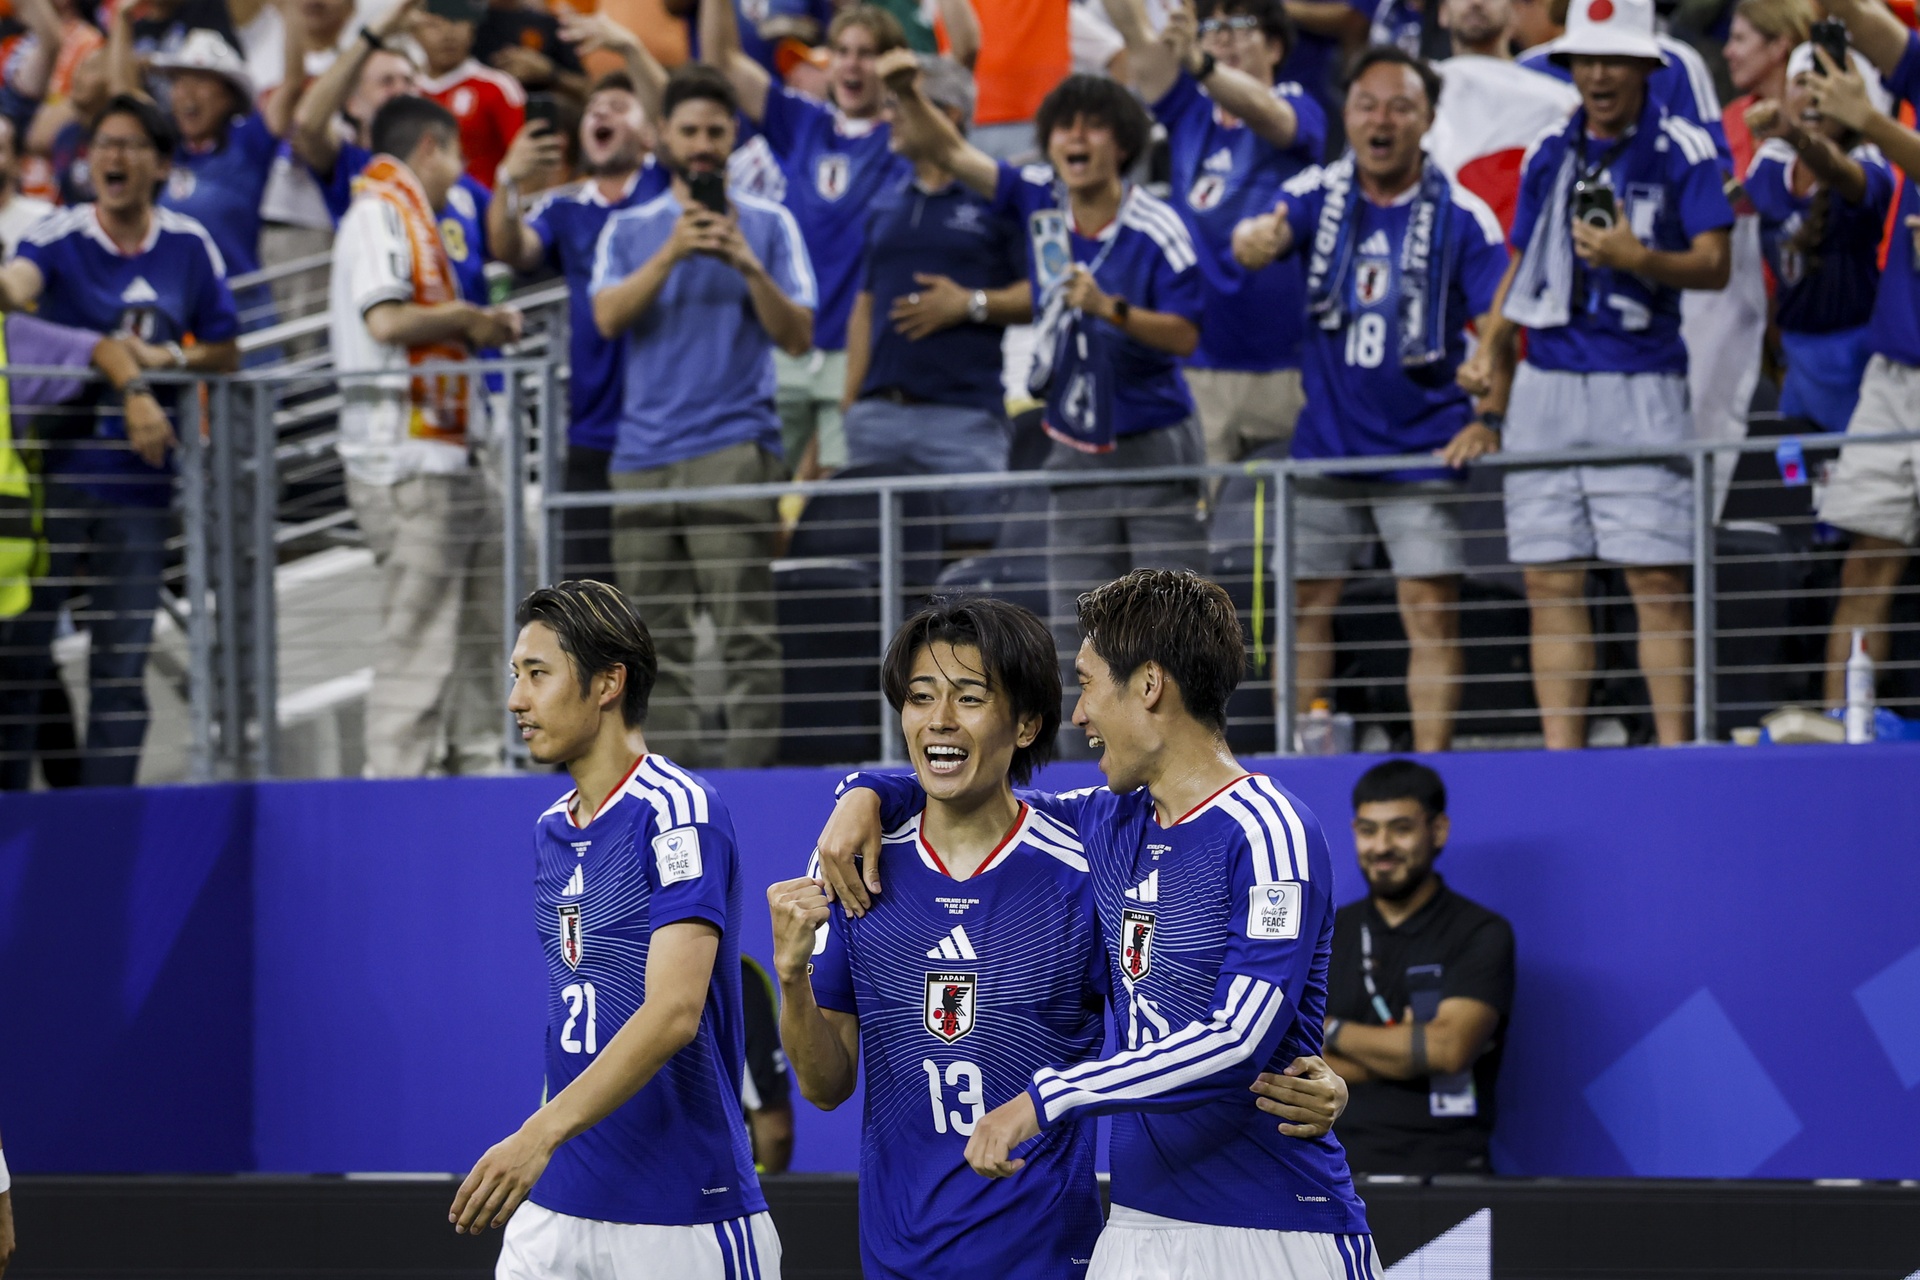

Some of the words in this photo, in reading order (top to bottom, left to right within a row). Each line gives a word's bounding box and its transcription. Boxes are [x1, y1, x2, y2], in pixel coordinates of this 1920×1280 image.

[1344, 312, 1387, 368] 18
[668, 859, 689, 872] PEACE
[1131, 912, 1150, 921] JAPAN
[1260, 906, 1278, 916] Unite
[1278, 907, 1288, 916] For
[1262, 916, 1286, 927] PEACE
[938, 974, 966, 982] JAPAN
[560, 981, 597, 1054] 21
[937, 1020, 961, 1031] JFA
[922, 1058, 986, 1137] 13
